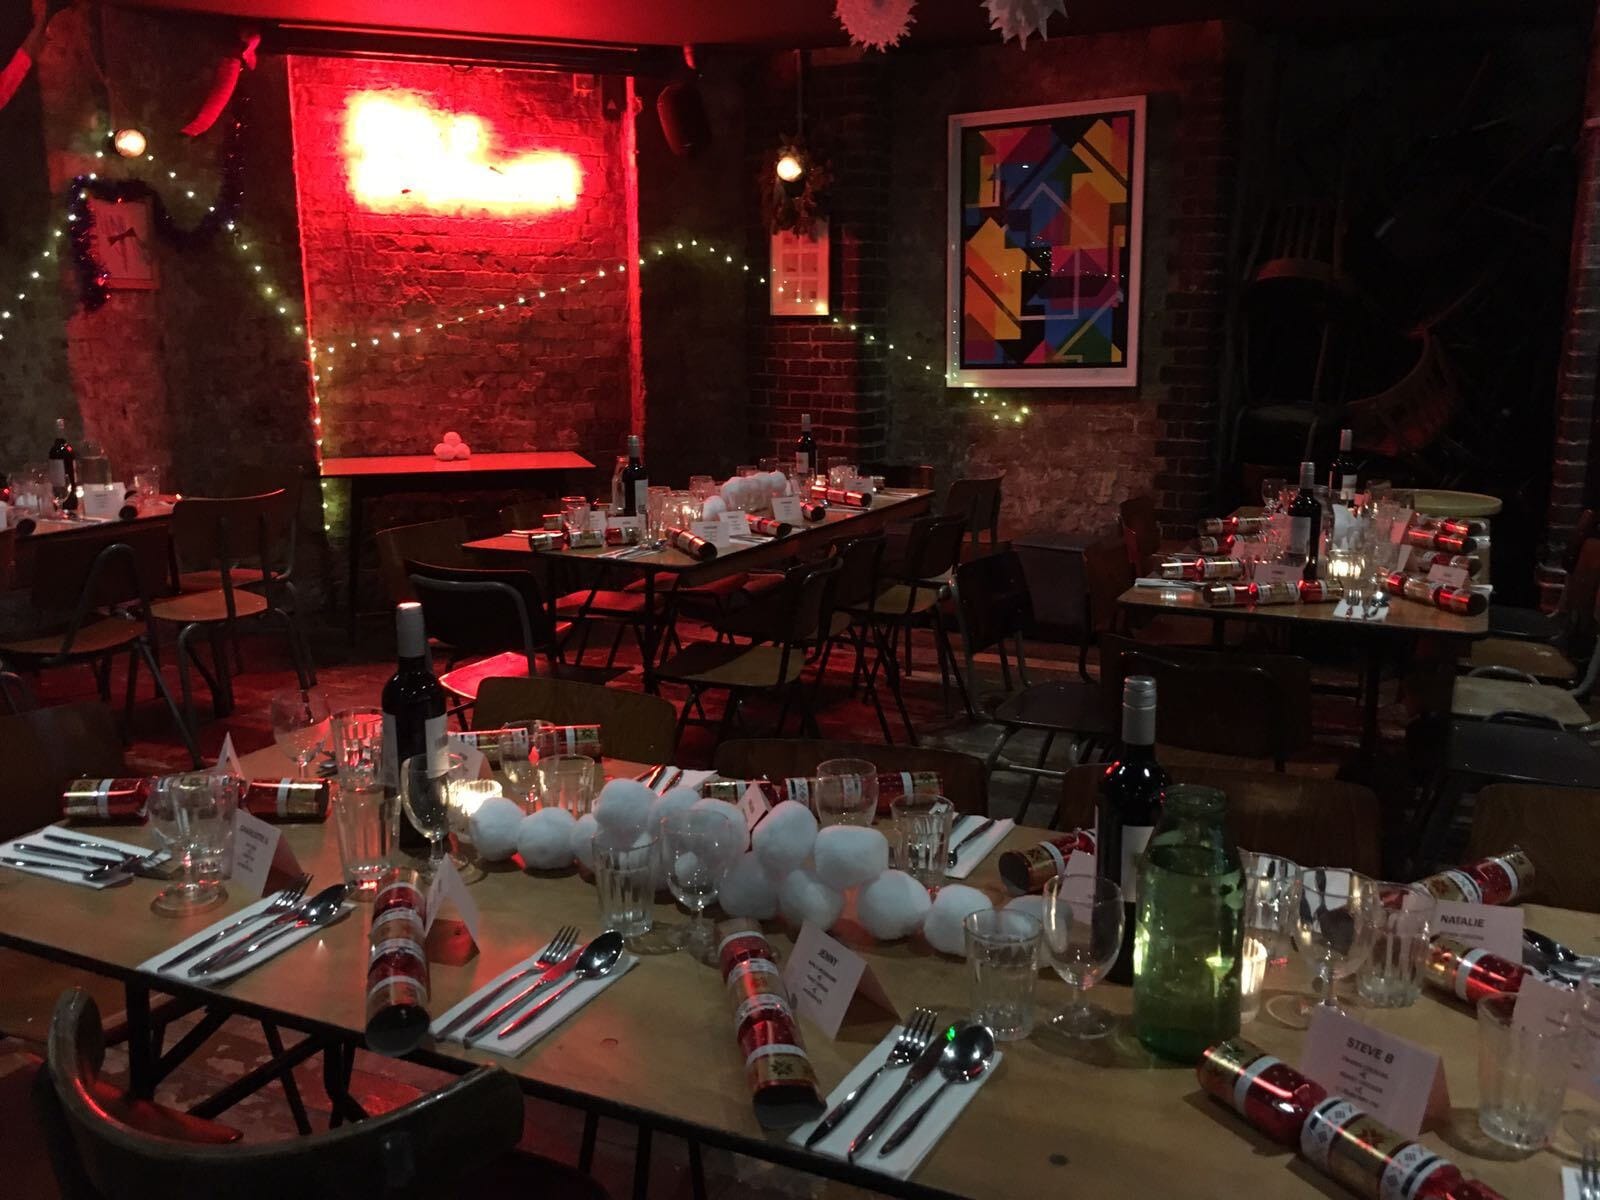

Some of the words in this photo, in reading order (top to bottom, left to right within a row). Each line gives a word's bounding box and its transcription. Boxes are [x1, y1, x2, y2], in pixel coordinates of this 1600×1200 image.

[1440, 914, 1486, 928] NATALIE
[1346, 1037, 1383, 1060] STEVE
[1384, 1053, 1395, 1064] B
